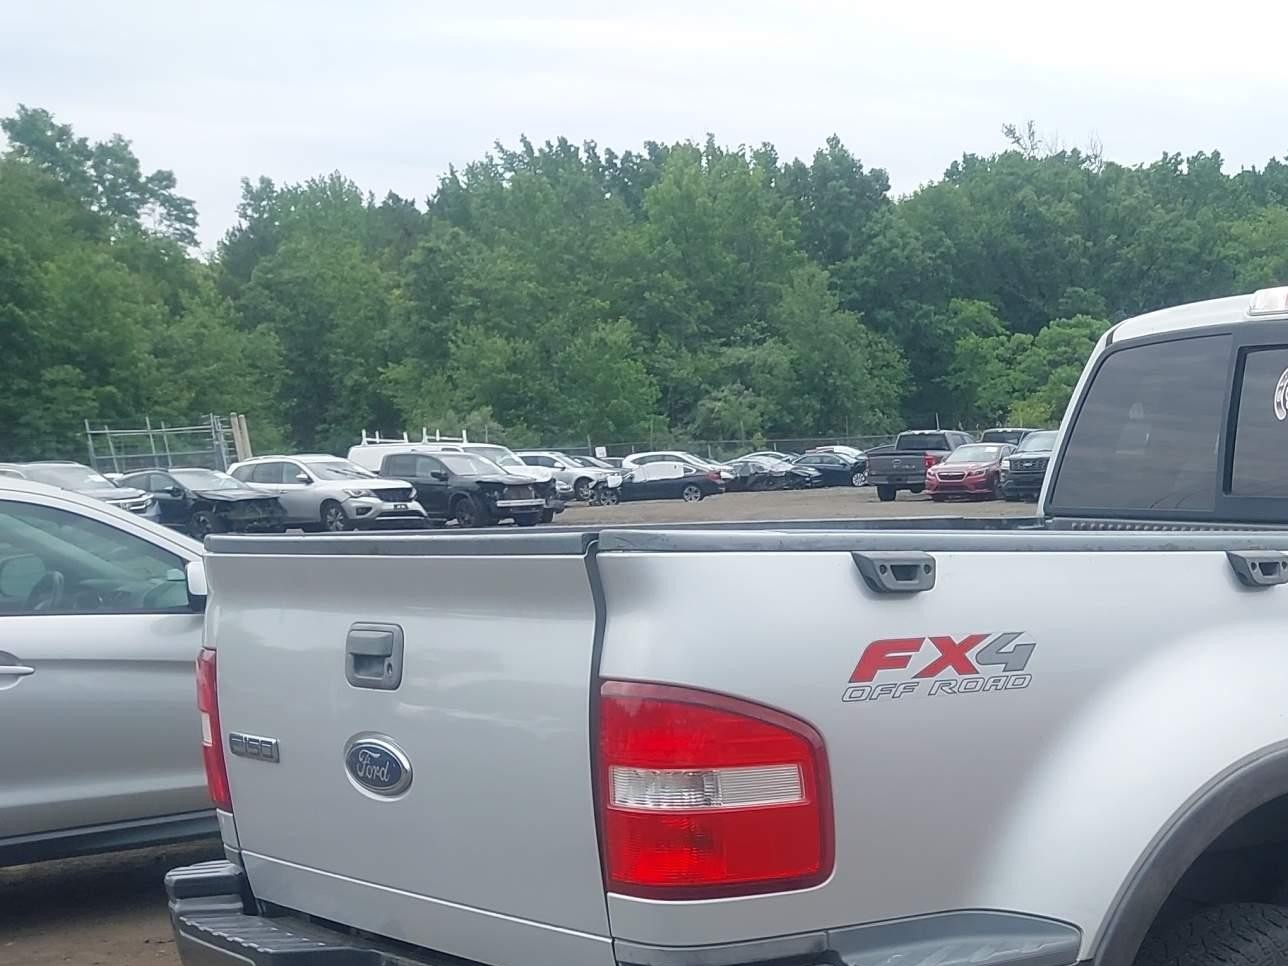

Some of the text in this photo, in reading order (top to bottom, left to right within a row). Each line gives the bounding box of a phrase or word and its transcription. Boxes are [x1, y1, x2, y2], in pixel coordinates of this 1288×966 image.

[848, 631, 1037, 684] FX4
[841, 673, 1033, 702] OFF ROAD
[356, 749, 391, 782] Ford
